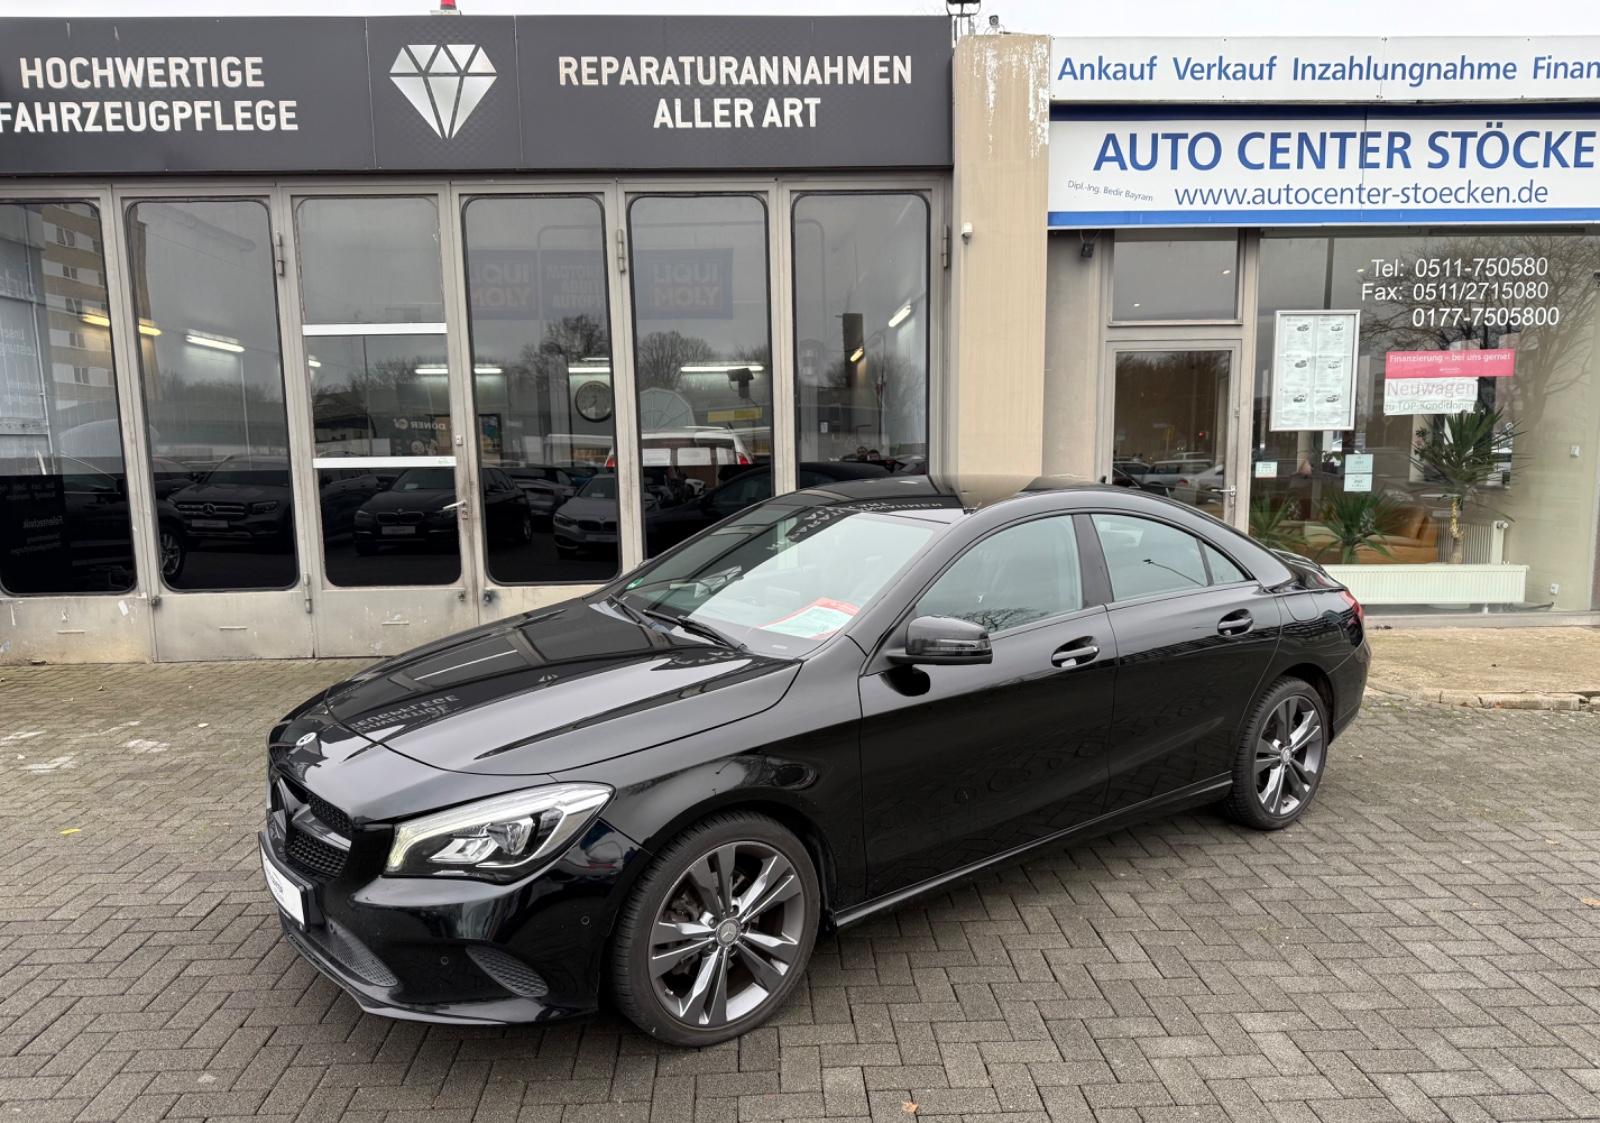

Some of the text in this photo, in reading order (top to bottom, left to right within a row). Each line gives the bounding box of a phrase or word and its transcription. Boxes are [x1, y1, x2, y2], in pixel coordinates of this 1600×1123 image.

[20, 57, 264, 89] HOCHWERTIGE
[559, 56, 912, 85] REPARATURANNAHMEN
[1058, 55, 1600, 87] Ankauf Verkauf Inzahlungnahme Finan
[0, 100, 298, 132] FAHRZEUGPFLEGE
[653, 98, 821, 128] ALLER ART
[1093, 122, 1596, 170] AUTO CENTER STÖCKE
[1103, 186, 1123, 197] Bedir
[1125, 190, 1153, 202] Bayram
[1174, 180, 1548, 205] www.autocenter-stoecken.de
[1371, 257, 1548, 277] Tel: 0511-750580
[655, 287, 719, 305] MOLY
[1361, 281, 1549, 301] Fax: 0511/2715080
[1412, 307, 1560, 327] 0177-7505800
[1390, 354, 1443, 363] Finanzierung
[1452, 353, 1464, 361] bei
[1387, 382, 1475, 398] Neuwagen
